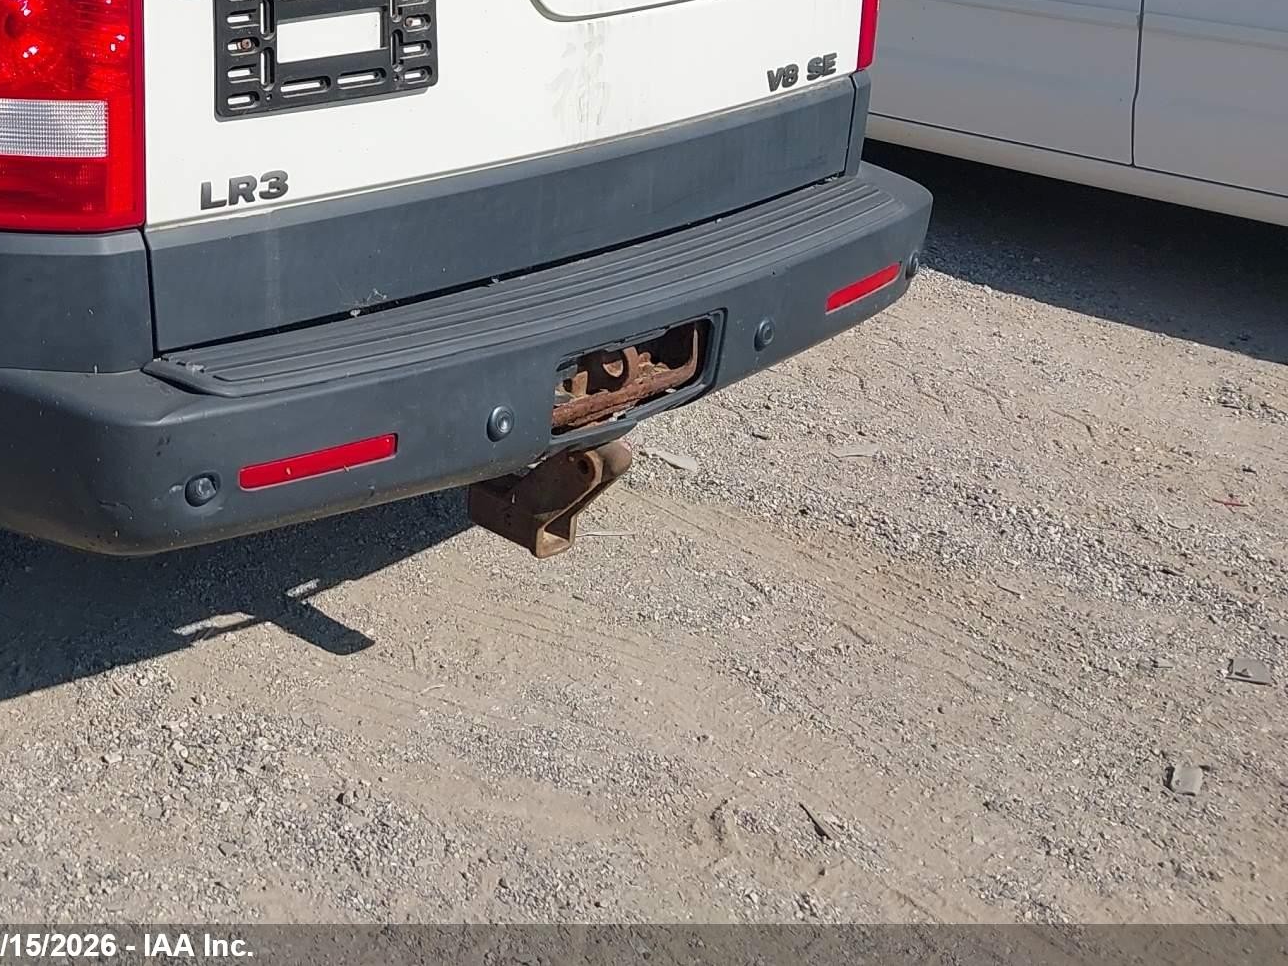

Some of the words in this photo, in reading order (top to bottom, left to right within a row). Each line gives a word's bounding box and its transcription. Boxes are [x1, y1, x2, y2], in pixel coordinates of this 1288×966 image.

[767, 63, 799, 92] V8
[806, 52, 837, 81] SE
[200, 169, 289, 210] LR3
